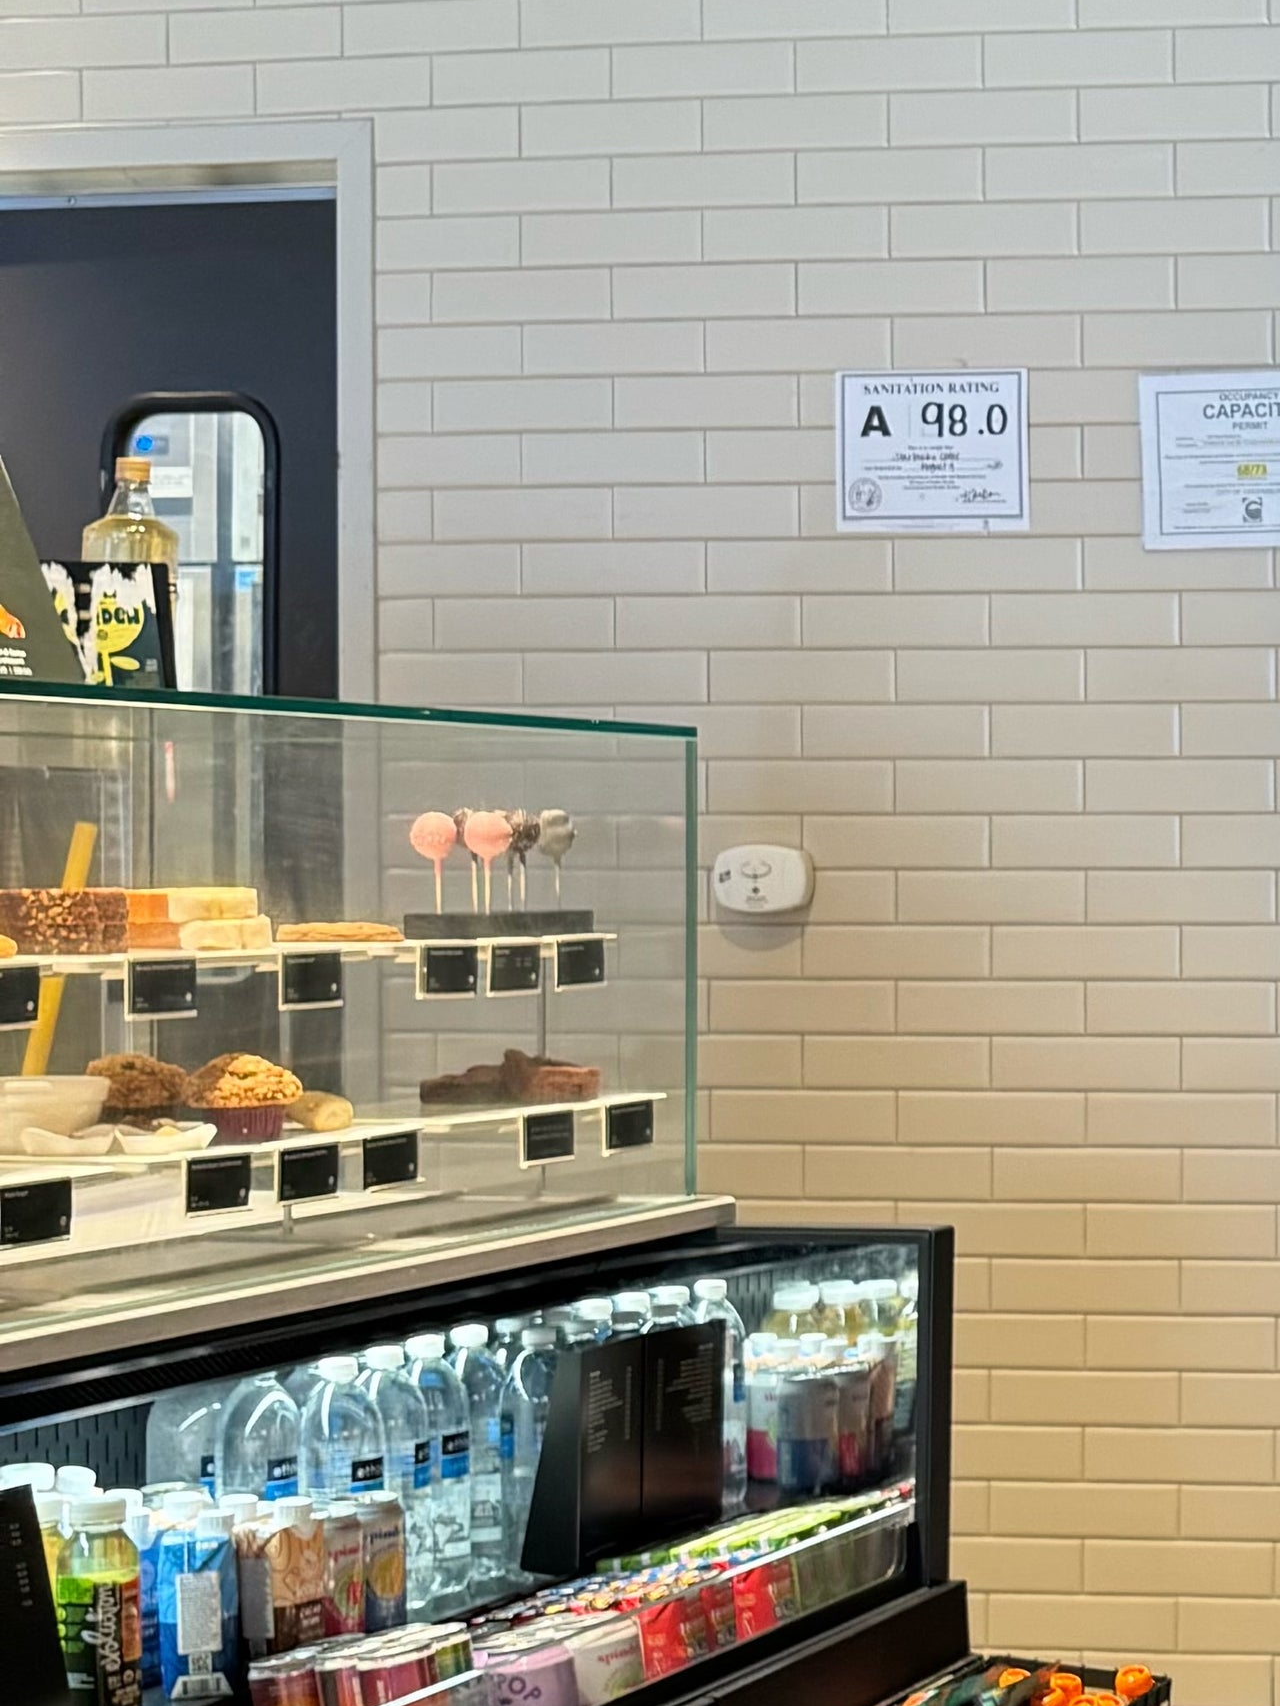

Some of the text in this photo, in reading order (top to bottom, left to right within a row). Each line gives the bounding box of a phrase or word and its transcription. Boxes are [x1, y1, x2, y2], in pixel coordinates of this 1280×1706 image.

[864, 381, 1000, 395] SANITATION RATING
[860, 404, 892, 438] A
[1232, 421, 1268, 431] PERMIT
